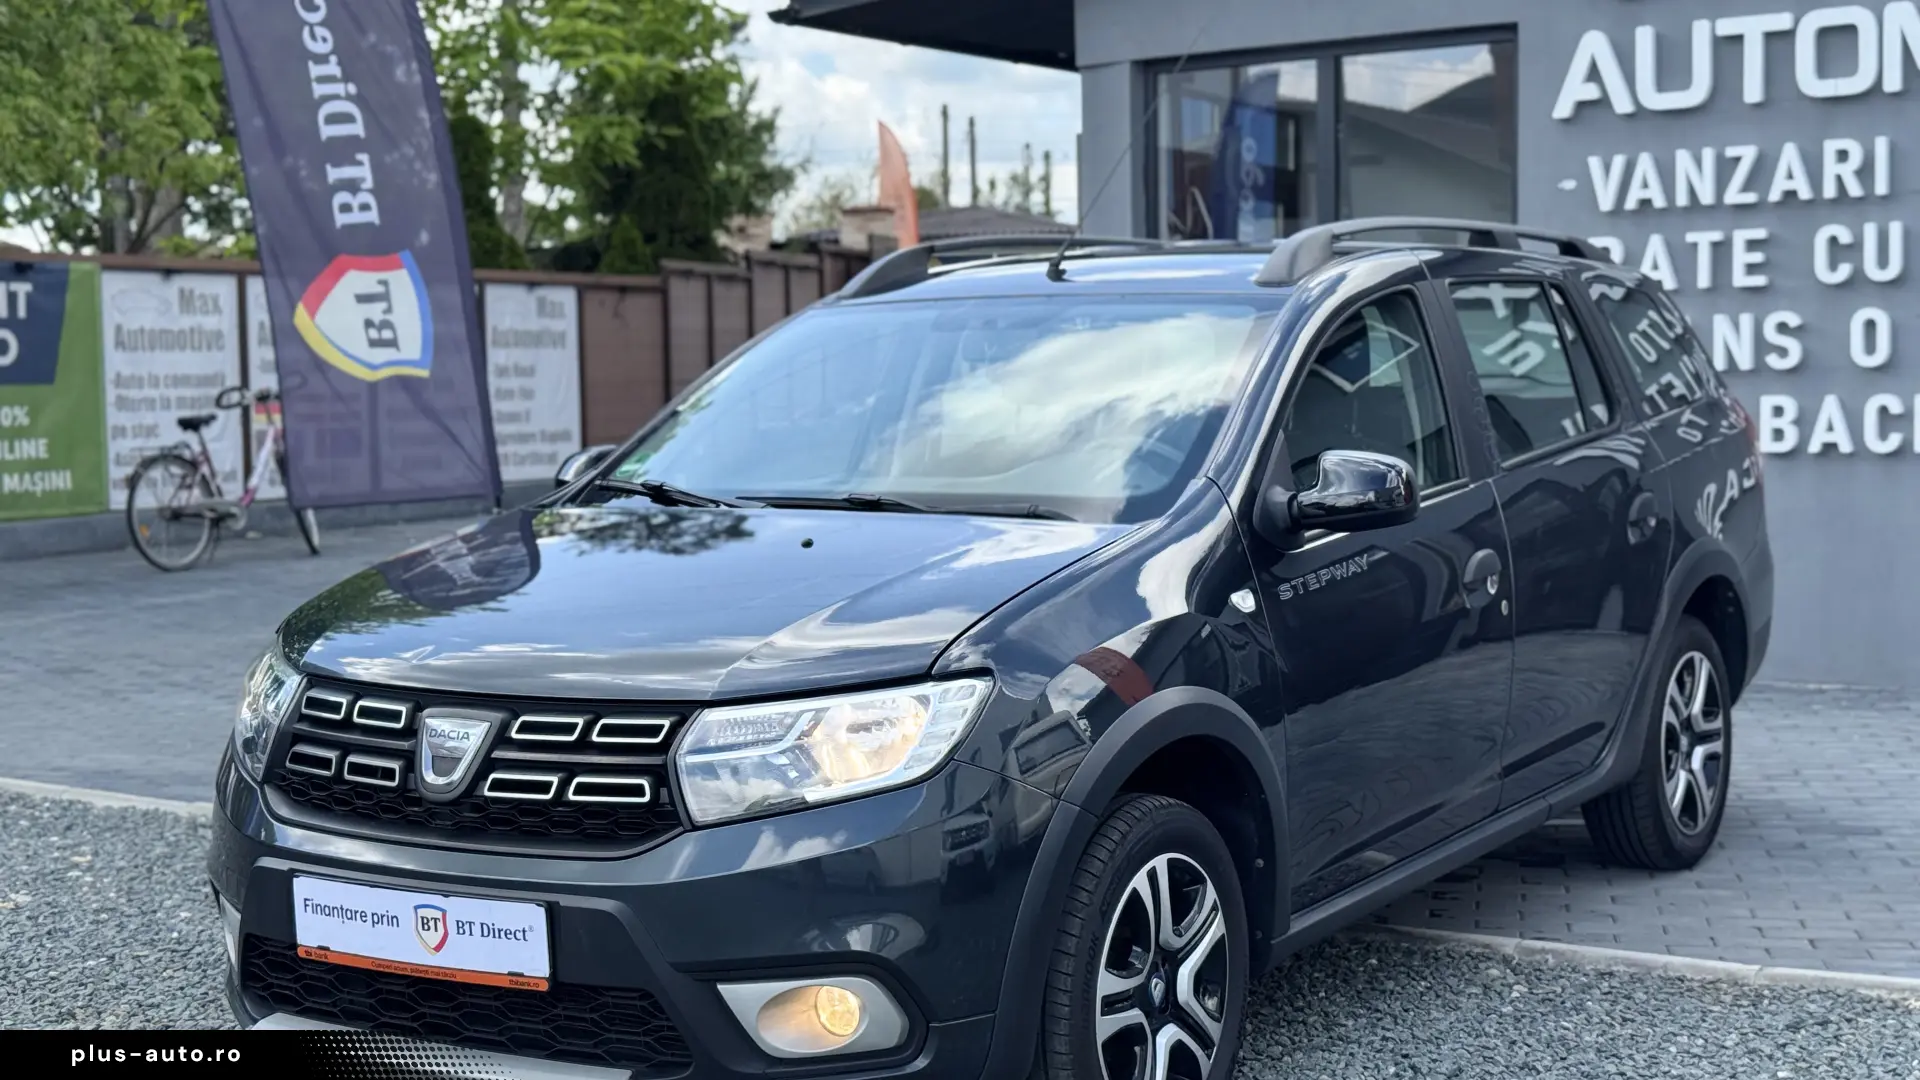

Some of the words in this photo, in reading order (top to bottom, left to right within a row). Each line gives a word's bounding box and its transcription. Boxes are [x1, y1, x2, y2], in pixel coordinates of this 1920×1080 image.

[1813, 220, 1905, 285] CU
[177, 286, 223, 316] Max
[114, 323, 226, 352] Automotive
[1684, 312, 1804, 372] NS
[1759, 393, 1920, 455] BAC
[1277, 553, 1368, 600] STEPWAY
[428, 728, 470, 742] DACIA
[370, 909, 400, 928] prin
[420, 915, 441, 933] BT
[455, 919, 476, 937] BT
